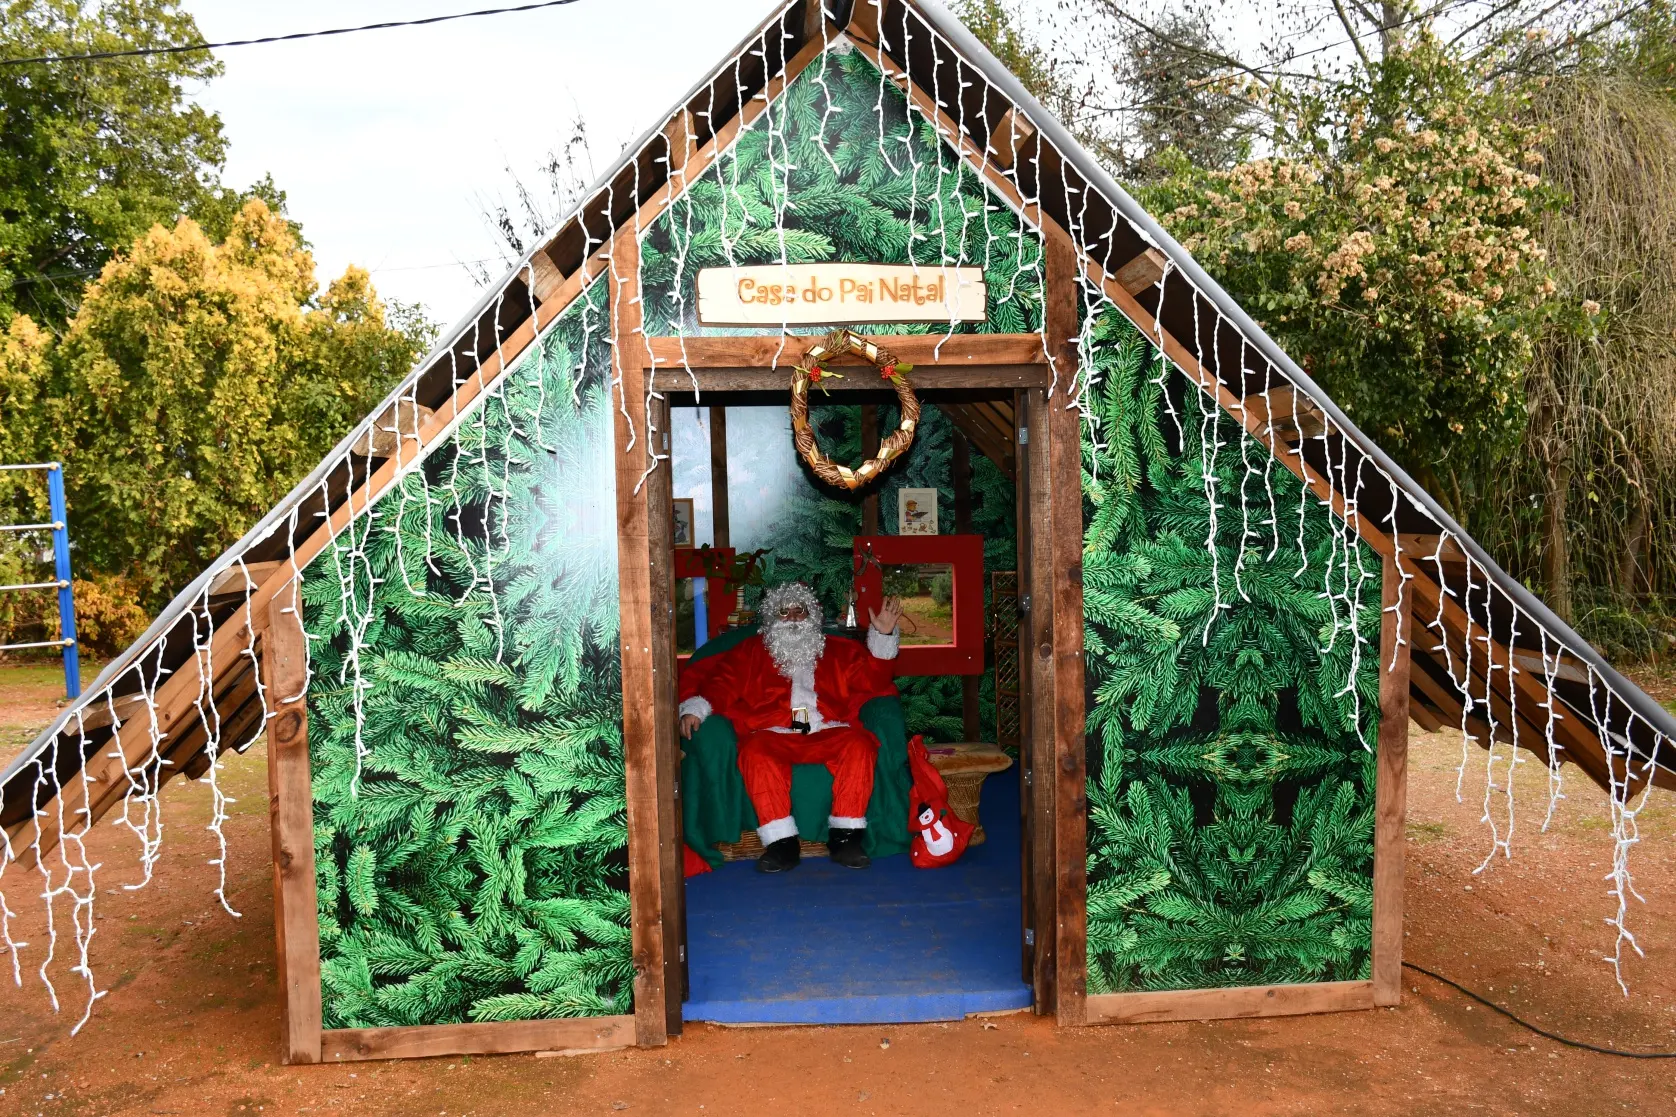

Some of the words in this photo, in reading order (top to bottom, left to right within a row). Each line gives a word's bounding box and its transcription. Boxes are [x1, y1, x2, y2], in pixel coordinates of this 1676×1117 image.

[738, 278, 795, 306] Casa
[802, 276, 833, 304] do
[839, 278, 873, 304] Pai
[879, 275, 944, 306] Natal
